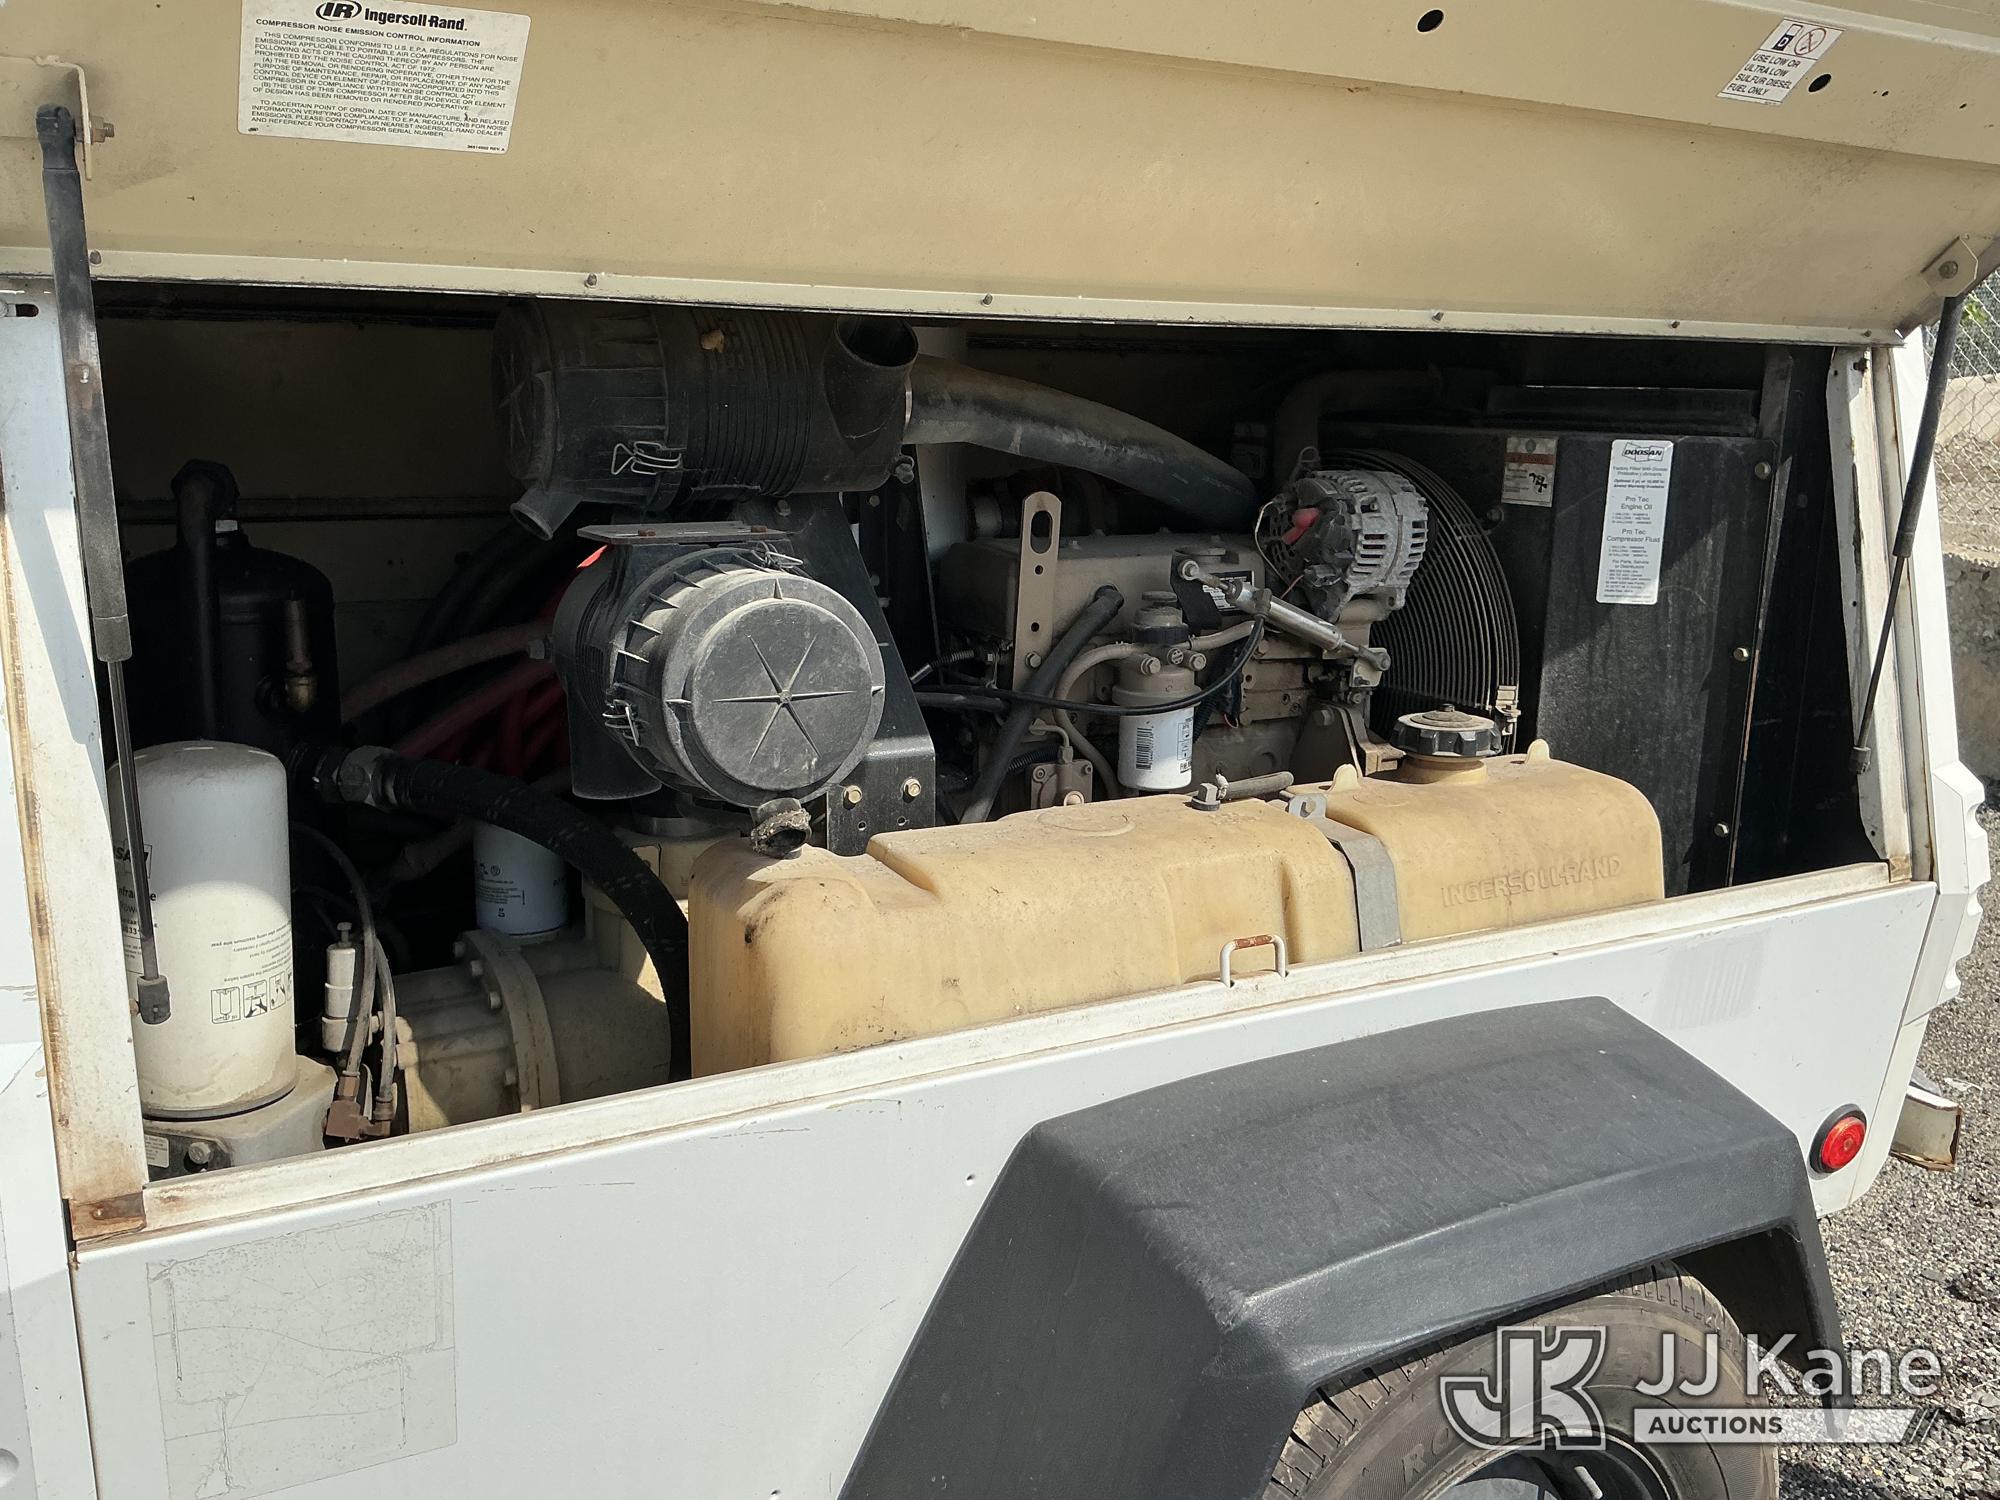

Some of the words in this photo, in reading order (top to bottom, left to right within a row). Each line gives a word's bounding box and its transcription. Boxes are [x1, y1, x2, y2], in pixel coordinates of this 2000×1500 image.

[256, 19, 315, 30] COMPRESSOR
[318, 25, 342, 33] NOISE
[345, 28, 384, 37] EMISSION
[386, 32, 424, 41] CONTROL
[427, 36, 480, 46] INFORMATION
[255, 37, 297, 46] EMISSIONS
[299, 41, 343, 51] APPLICABLE
[357, 47, 394, 56] PORTABLE
[283, 34, 337, 44] COMPRESSOR
[339, 39, 381, 48] CONFORMS
[430, 48, 479, 58] REGULATIONS
[255, 43, 299, 53] FOLLOWING
[352, 53, 385, 61] CAUSING
[387, 56, 420, 64] THEREOF
[449, 62, 479, 70] PERSON
[255, 50, 300, 59] PROHIBITED
[355, 59, 388, 67] CONTROL
[1753, 53, 1770, 64] USE
[1768, 56, 1788, 66] LOW
[1787, 58, 1801, 68] OR
[254, 62, 290, 70] PURPOSE
[291, 59, 325, 67] REMOVAL
[341, 64, 384, 73] RENDERING
[1744, 63, 1768, 74] ULTRA
[1768, 67, 1789, 77] LOW
[253, 68, 289, 77] CONTROL
[334, 76, 367, 84] ELEMENT
[410, 83, 465, 93] INCORPORATED
[253, 74, 306, 84] COMPRESSOR
[317, 80, 364, 89] COMPLIANCE
[425, 90, 458, 98] CONTROL
[1736, 73, 1768, 85] SULFUR
[1768, 79, 1792, 89] DIESEL
[336, 88, 387, 98] COMPRESSOR
[1727, 83, 1747, 93] FUEL
[1748, 86, 1769, 96] ONLY
[333, 94, 369, 102] REMOVED
[383, 98, 422, 107] RENDERED
[252, 105, 302, 114] INFORMATION
[304, 109, 342, 117] VERIFYING
[344, 113, 389, 121] COMPLIANCE
[422, 119, 469, 128] REGULATIONS
[272, 100, 312, 109] ASCERTAIN
[480, 118, 510, 126] RELATED
[269, 118, 312, 126] REFERENCE
[336, 123, 386, 132] COMPRESSOR
